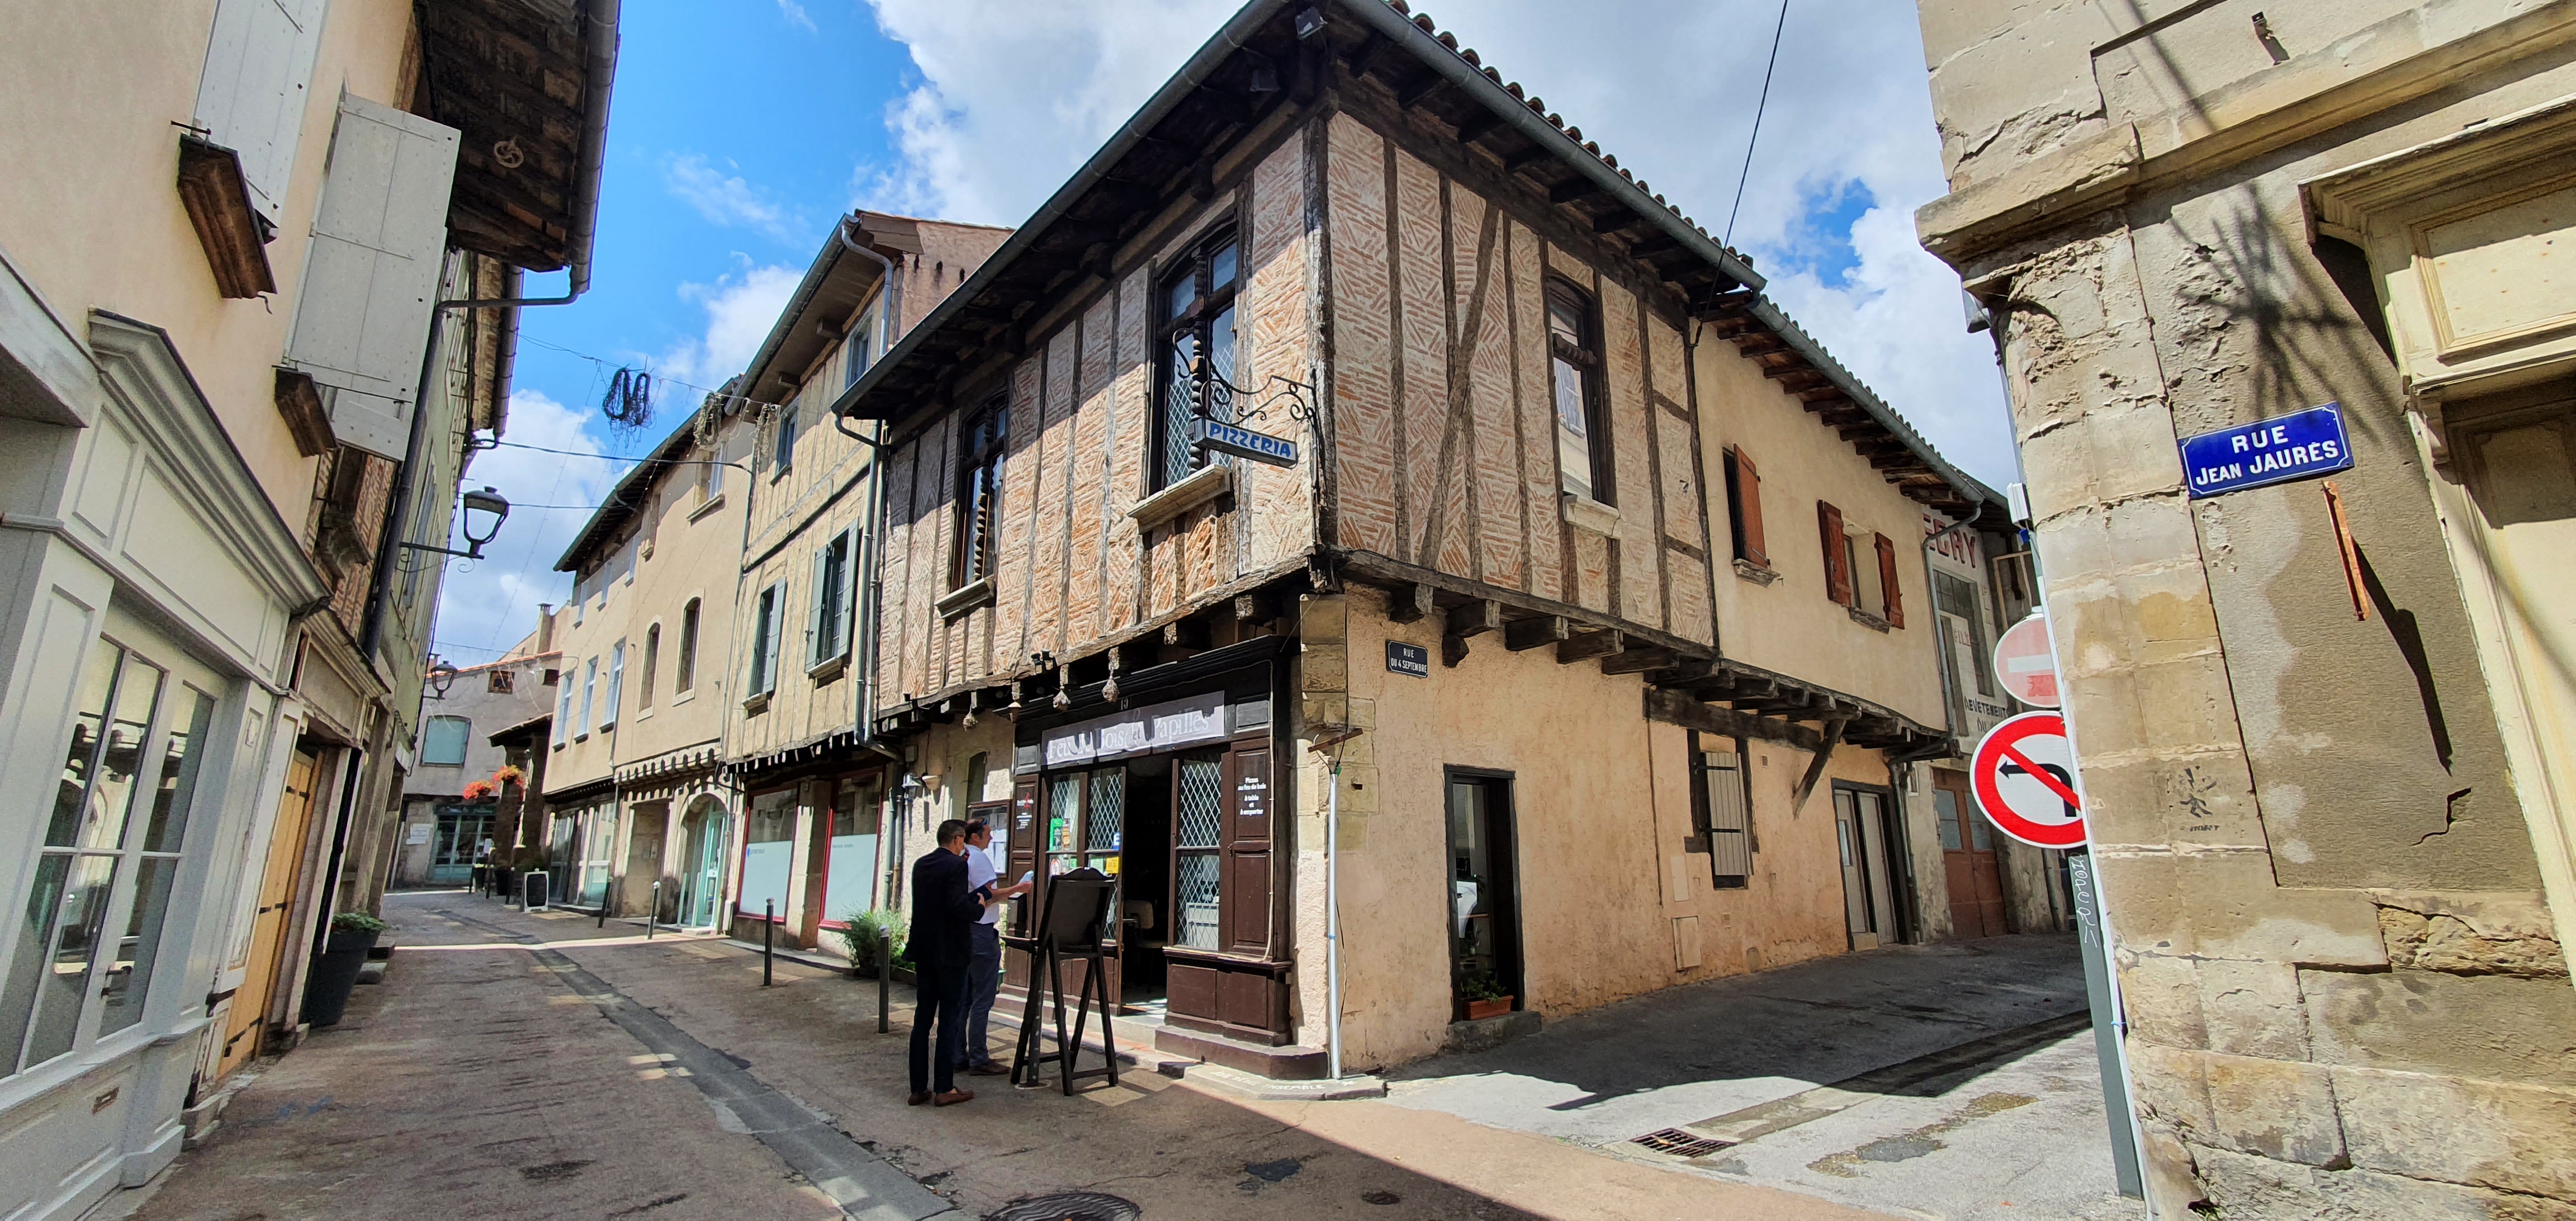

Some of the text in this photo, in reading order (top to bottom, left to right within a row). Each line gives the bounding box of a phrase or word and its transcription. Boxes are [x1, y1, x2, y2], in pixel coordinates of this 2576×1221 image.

[1209, 422, 1291, 458] PIZZERIA
[2231, 425, 2289, 454] RUE
[2195, 439, 2340, 486] JEAN JAURÈS
[1390, 657, 1427, 673] DU 4 SEPTEMBRE
[1403, 647, 1414, 658] RUE
[1152, 707, 1210, 743] Papilles
